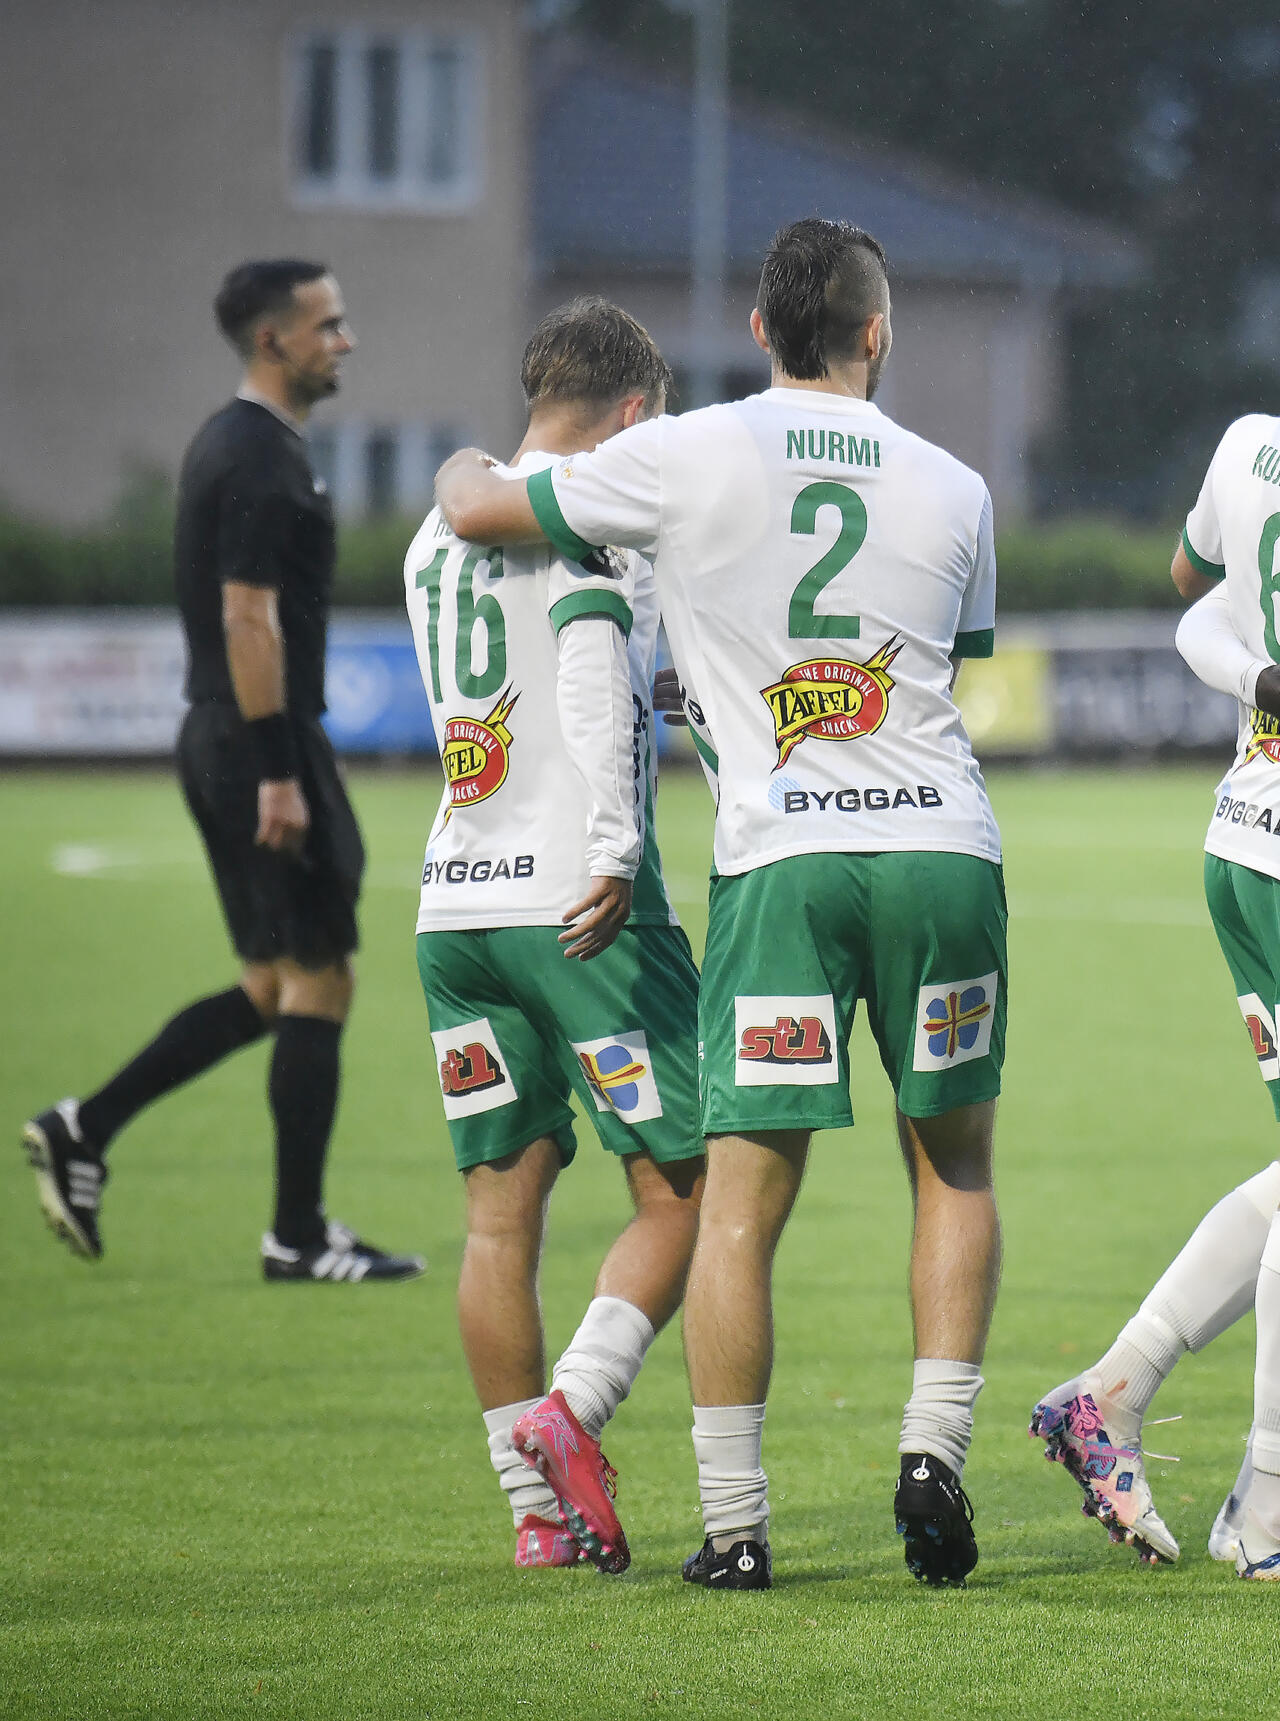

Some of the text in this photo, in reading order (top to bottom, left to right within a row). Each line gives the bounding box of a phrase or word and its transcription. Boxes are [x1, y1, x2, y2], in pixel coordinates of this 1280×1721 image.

[786, 429, 881, 468] NURMI
[788, 482, 868, 640] 2
[416, 545, 507, 704] 16
[799, 665, 876, 697] THE ORIGINAL
[769, 688, 858, 732] TAFFEL
[821, 720, 861, 735] SNACKS
[454, 724, 498, 754] ORIGINAL
[784, 785, 943, 815] BYGGAB
[422, 854, 534, 886] BYGGAB
[738, 1017, 832, 1065] st1
